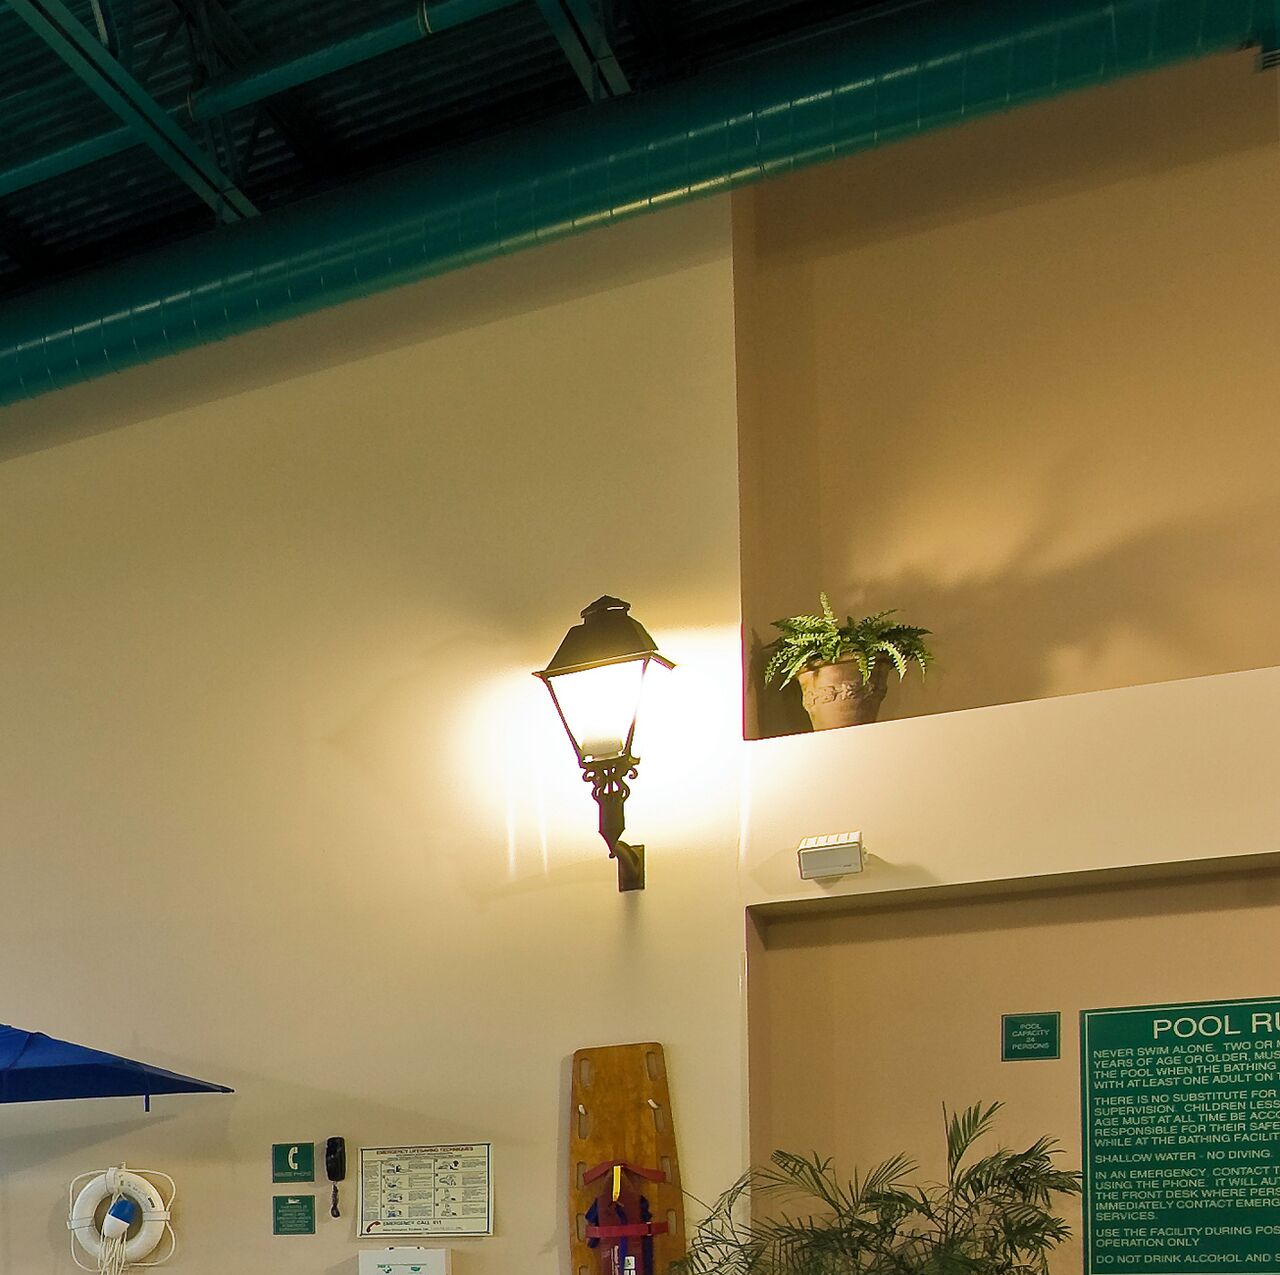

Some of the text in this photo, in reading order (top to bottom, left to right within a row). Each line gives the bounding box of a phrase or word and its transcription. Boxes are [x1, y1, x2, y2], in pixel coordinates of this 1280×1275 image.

[1153, 1014, 1241, 1040] POOL
[1093, 1048, 1134, 1059] NEVER
[1137, 1046, 1169, 1057] SWIM
[1223, 1041, 1251, 1051] TWO
[1254, 1040, 1273, 1049] OR
[1094, 1058, 1133, 1069] YEARS
[1136, 1057, 1153, 1067] OF
[1156, 1056, 1181, 1066] AGE
[1184, 1055, 1203, 1064] OR
[1094, 1061, 1277, 1079] THE POOL WHEN THE BATHING
[1094, 1080, 1124, 1090] WITH
[1127, 1079, 1140, 1088] AT
[1142, 1077, 1180, 1087] LEAST
[1183, 1075, 1209, 1085] ONE
[1212, 1073, 1253, 1084] ADULT
[1254, 1072, 1273, 1081] ON
[1094, 1089, 1277, 1106] THERE IS NO SUBSTITUTE FOR
[1184, 1101, 1246, 1113] CHILDREN
[1094, 1117, 1119, 1127] AGE
[1122, 1115, 1155, 1125] MUST
[1158, 1115, 1172, 1124] AT
[1173, 1114, 1195, 1123] ALL
[1198, 1113, 1227, 1122] TIME
[1230, 1112, 1246, 1121] BE
[1095, 1125, 1178, 1137] RESPONSIBLE
[1181, 1124, 1206, 1134] FOR
[1209, 1123, 1246, 1132] THEIR
[1095, 1137, 1132, 1147] WHILE
[1135, 1137, 1149, 1146] AT
[1151, 1136, 1175, 1145] THE
[1178, 1134, 1231, 1144] BATHING
[1095, 1153, 1152, 1164] SHALLOW
[1155, 1151, 1196, 1162] WATER
[1207, 1150, 1224, 1160] NO
[1095, 1171, 1107, 1180] IN
[1110, 1170, 1126, 1179] AN
[1212, 1166, 1270, 1176] CONTACT
[1095, 1180, 1133, 1190] USING
[1135, 1180, 1160, 1189] THE
[1215, 1178, 1225, 1187] IT
[1228, 1177, 1258, 1187] WILL
[1095, 1191, 1118, 1200] THE
[1122, 1190, 1163, 1200] FRONT
[1166, 1189, 1198, 1199] DESK
[1201, 1188, 1246, 1198] WHERE
[1096, 1198, 1280, 1210] IMMEDIATELY CONTACT EMERG
[1096, 1228, 1120, 1237] USE
[1123, 1228, 1147, 1237] THE
[1150, 1226, 1202, 1237] FACILITY
[1205, 1225, 1252, 1236] DURING
[1096, 1238, 1164, 1248] OPERATION
[1096, 1255, 1114, 1264] DO
[1117, 1255, 1141, 1263] NOT
[1144, 1254, 1181, 1263] DRINK
[1184, 1254, 1241, 1263] ALCOHOL
[1245, 1253, 1271, 1263] AND
